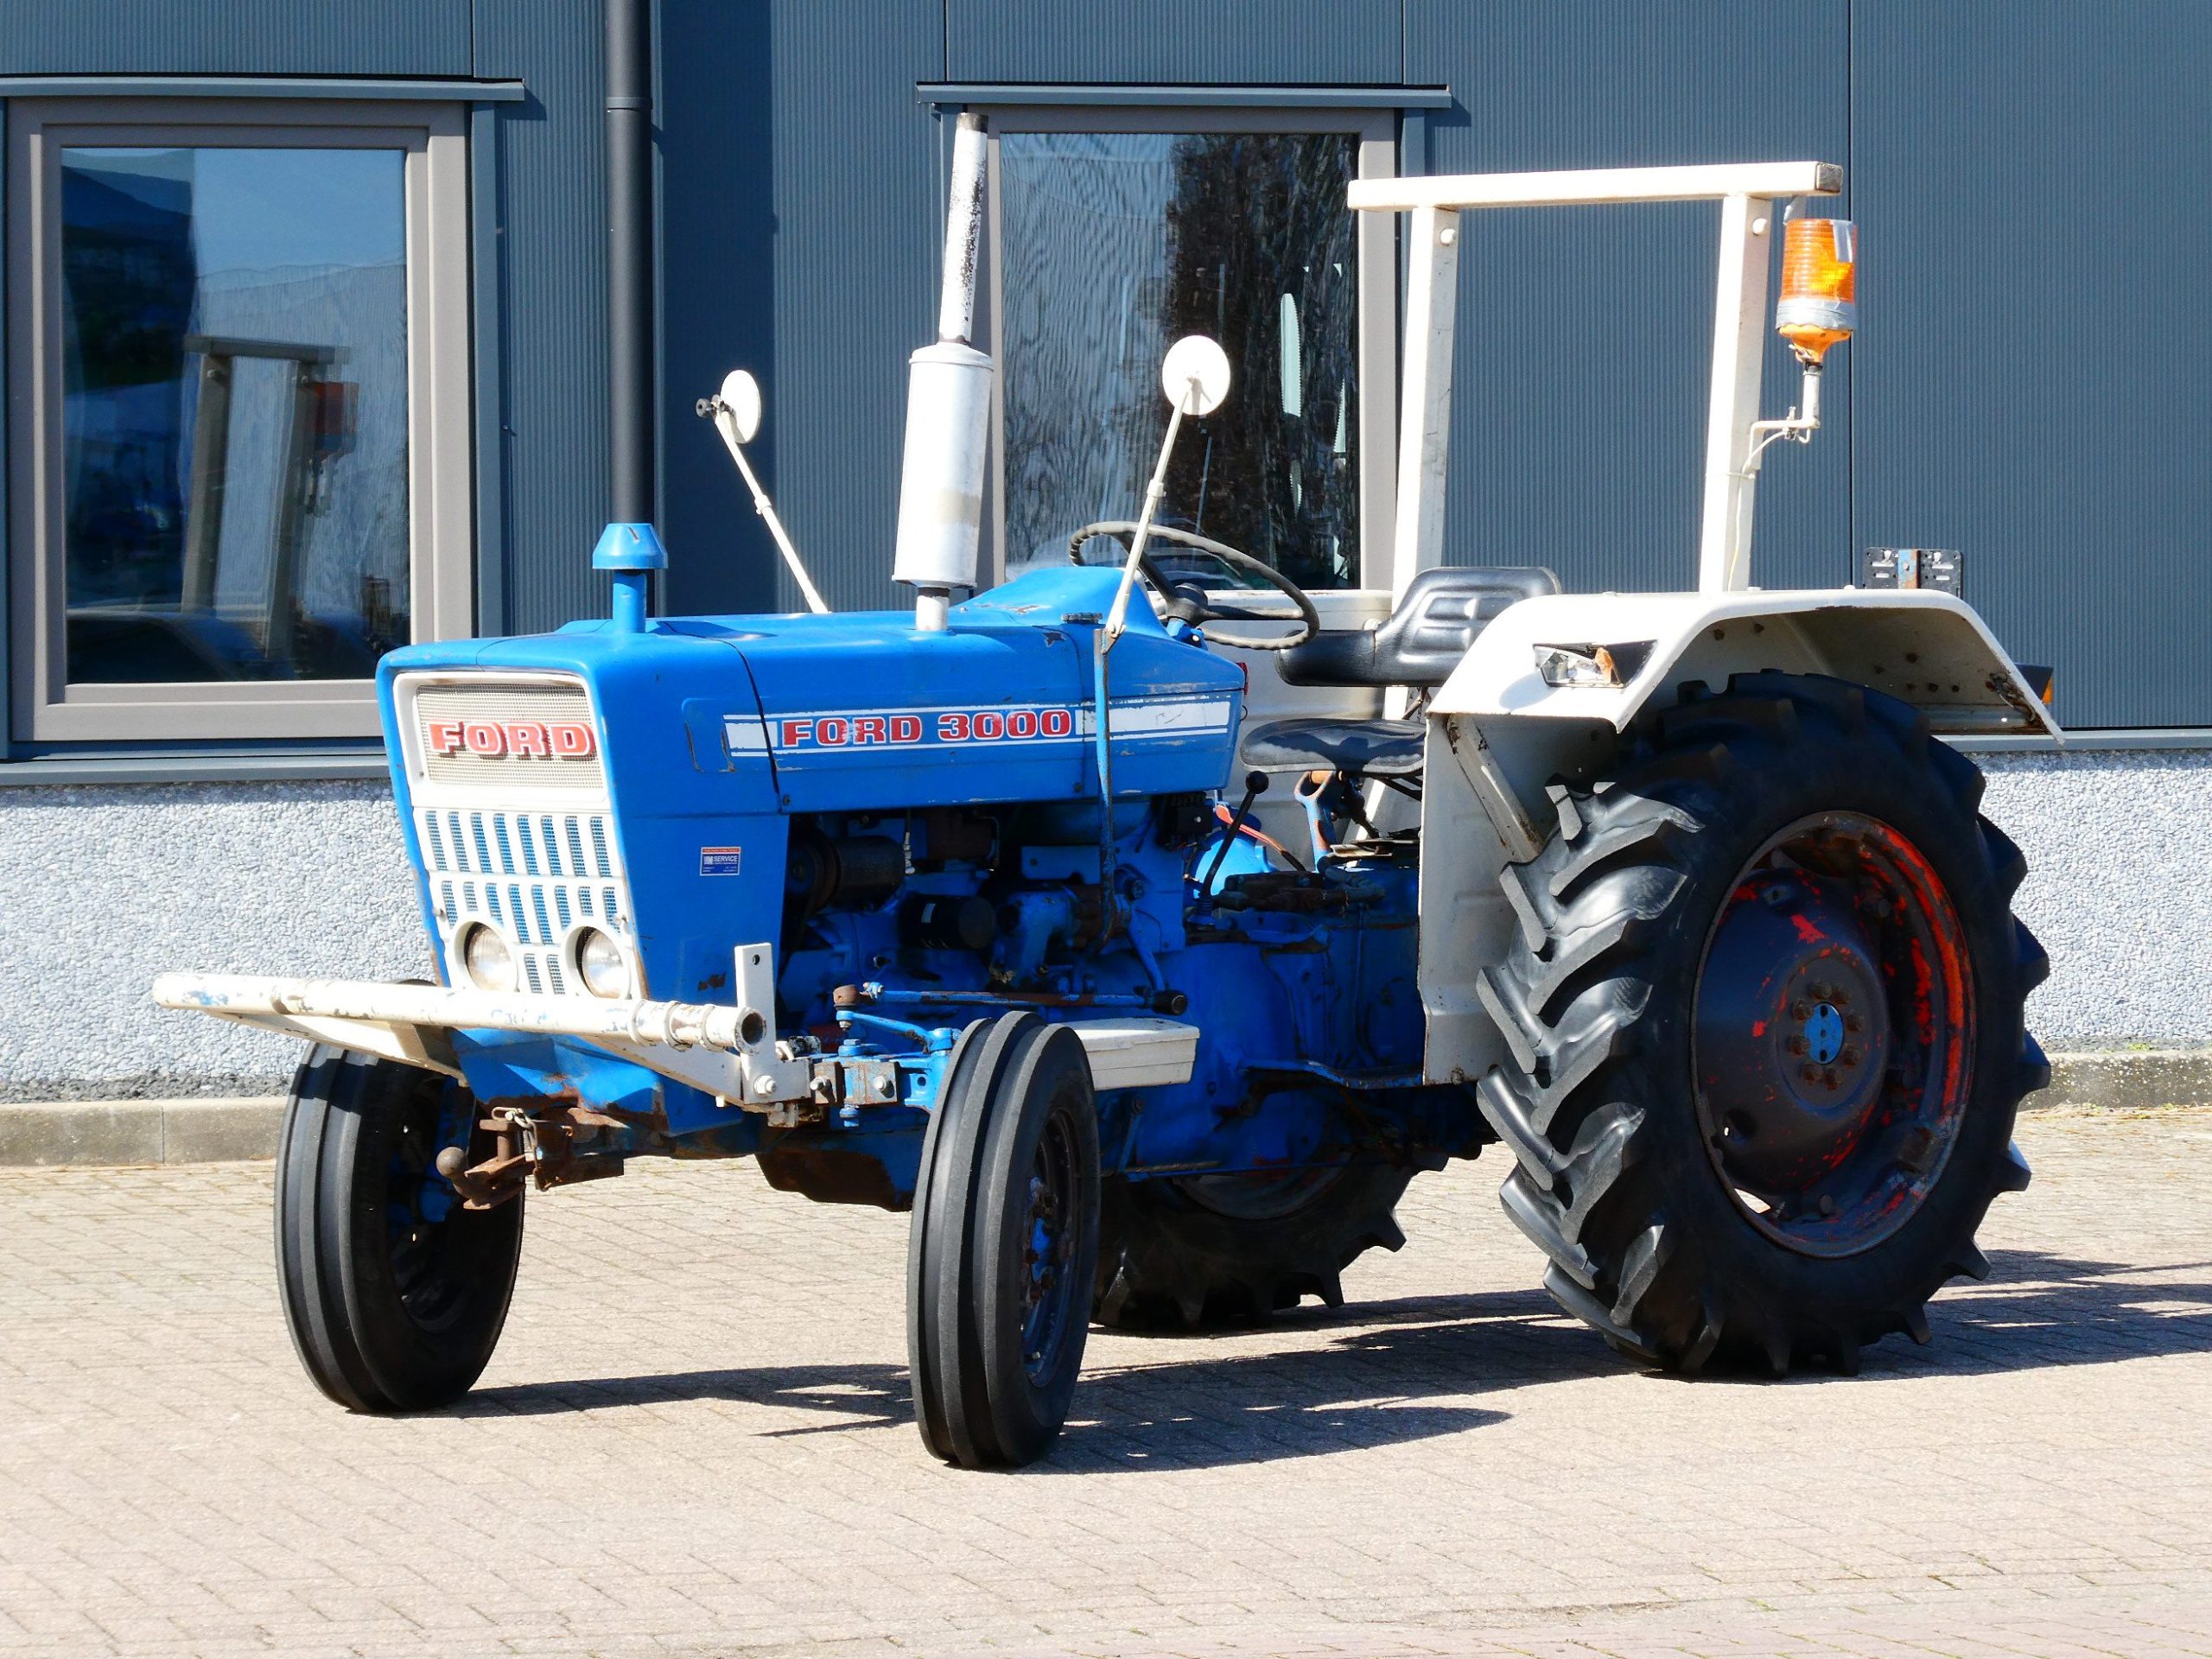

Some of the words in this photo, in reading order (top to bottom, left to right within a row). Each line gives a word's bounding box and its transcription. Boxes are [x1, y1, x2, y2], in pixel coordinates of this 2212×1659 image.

[427, 719, 597, 760] FORD
[782, 715, 923, 746] FORD
[938, 709, 1072, 740] 3000
